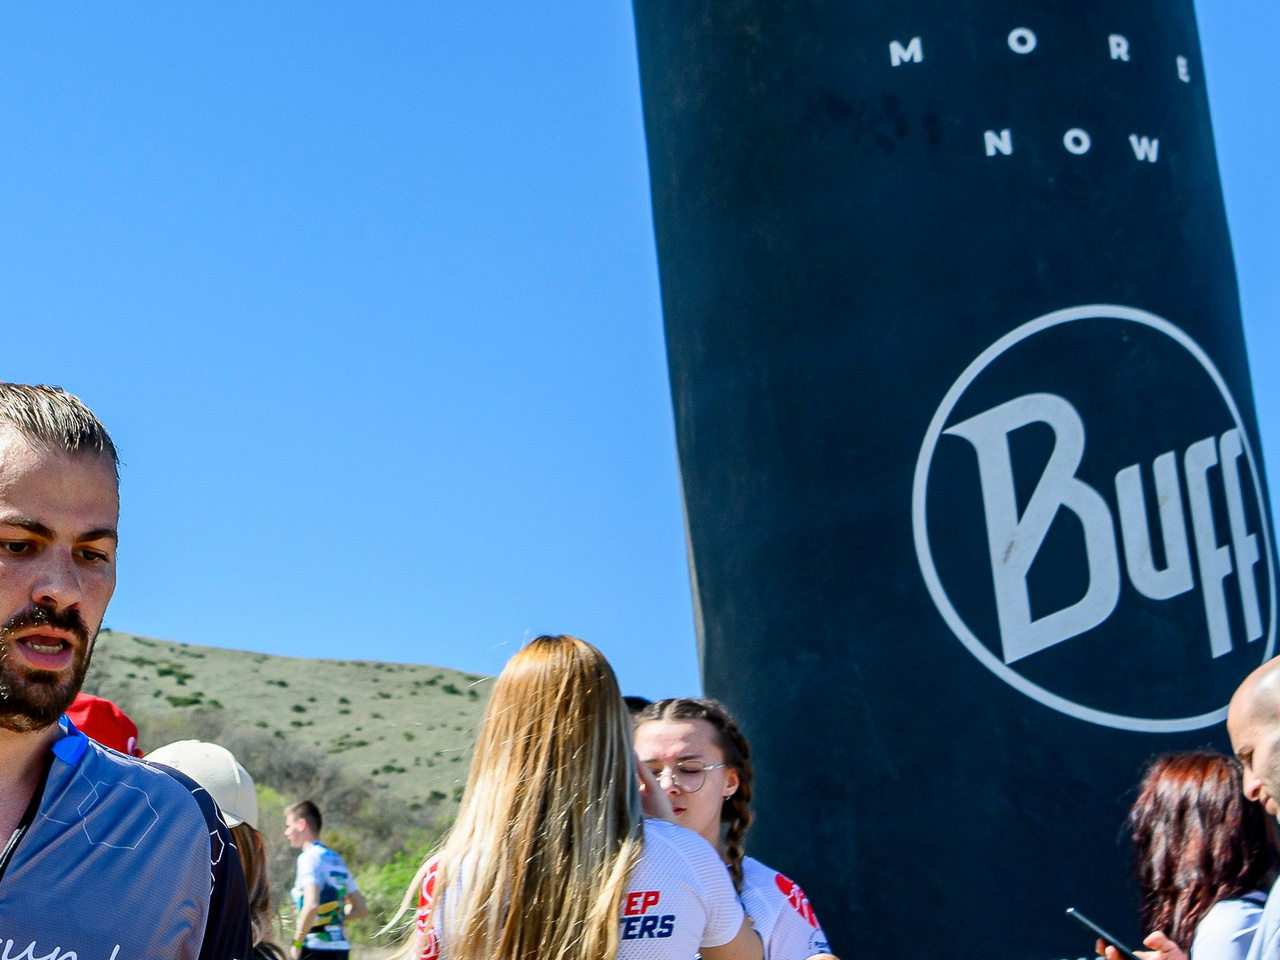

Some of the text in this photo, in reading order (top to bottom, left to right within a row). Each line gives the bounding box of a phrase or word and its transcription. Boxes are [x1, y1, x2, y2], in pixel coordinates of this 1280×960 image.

[889, 27, 1190, 84] MORE
[984, 128, 1159, 163] NOW
[623, 890, 661, 916] EP
